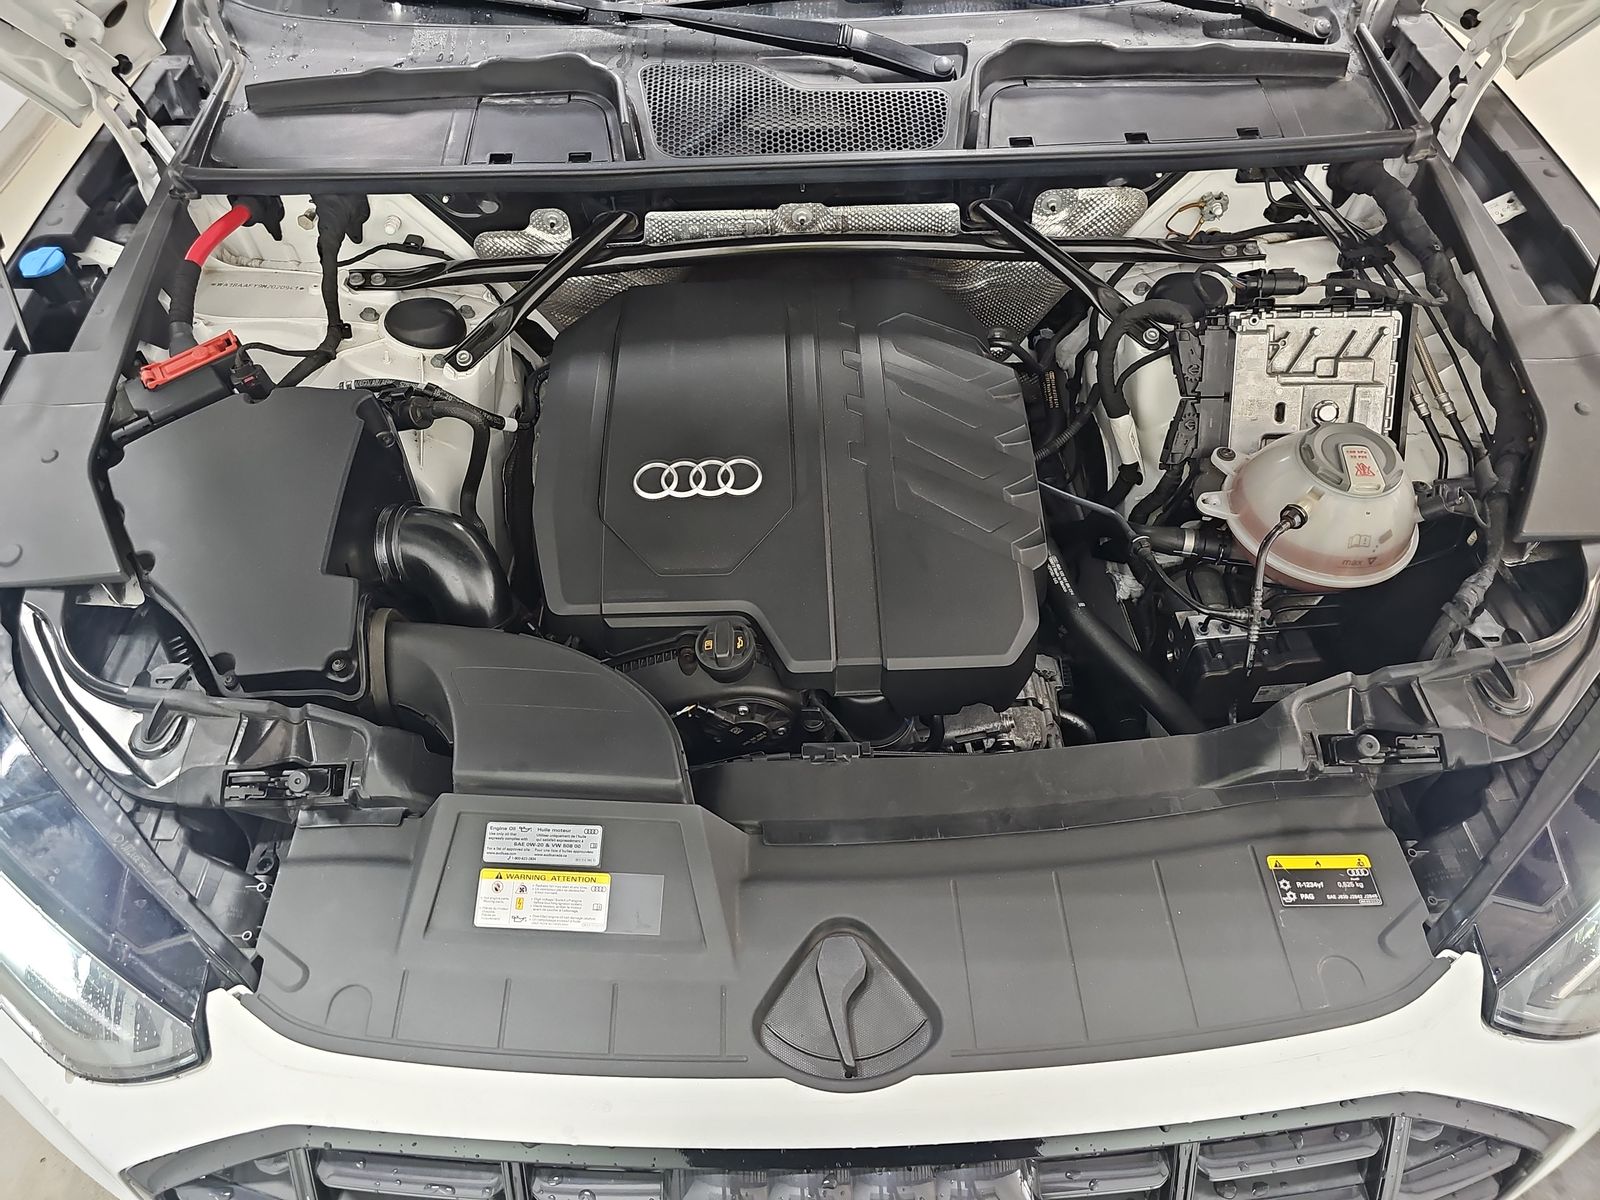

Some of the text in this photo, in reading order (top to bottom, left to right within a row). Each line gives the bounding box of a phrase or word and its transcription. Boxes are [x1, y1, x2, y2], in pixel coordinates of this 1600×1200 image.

[506, 873, 597, 883] WARNING ATTENTION
[1355, 881, 1364, 889] kg
